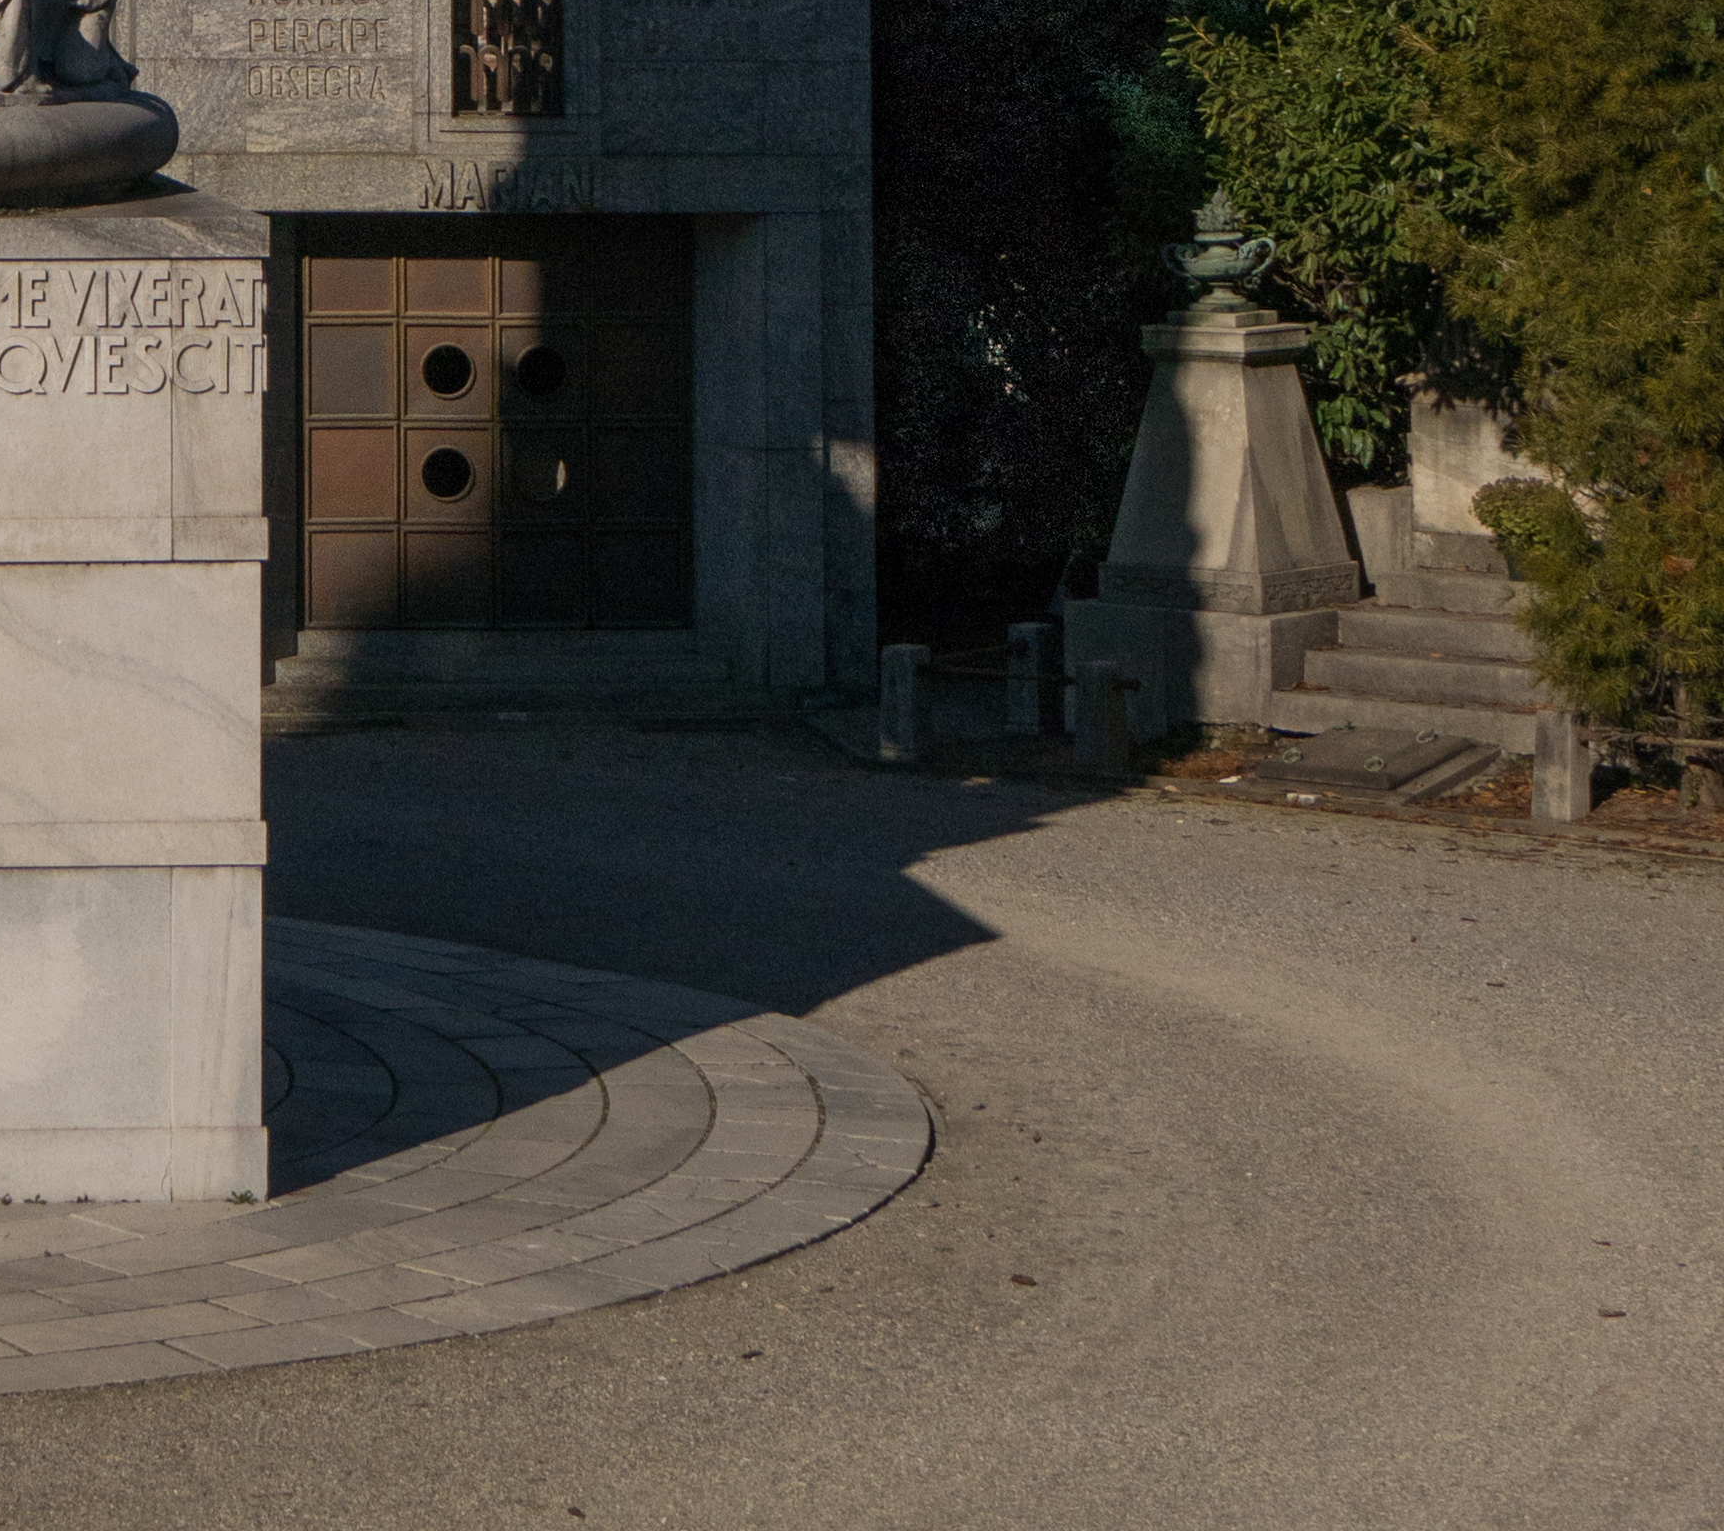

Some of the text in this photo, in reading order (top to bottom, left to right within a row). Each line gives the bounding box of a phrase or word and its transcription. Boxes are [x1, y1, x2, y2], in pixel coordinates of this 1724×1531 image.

[248, 18, 388, 53] PERCIPE
[248, 65, 388, 100] OBSECRA
[60, 269, 264, 329] VIXERAT
